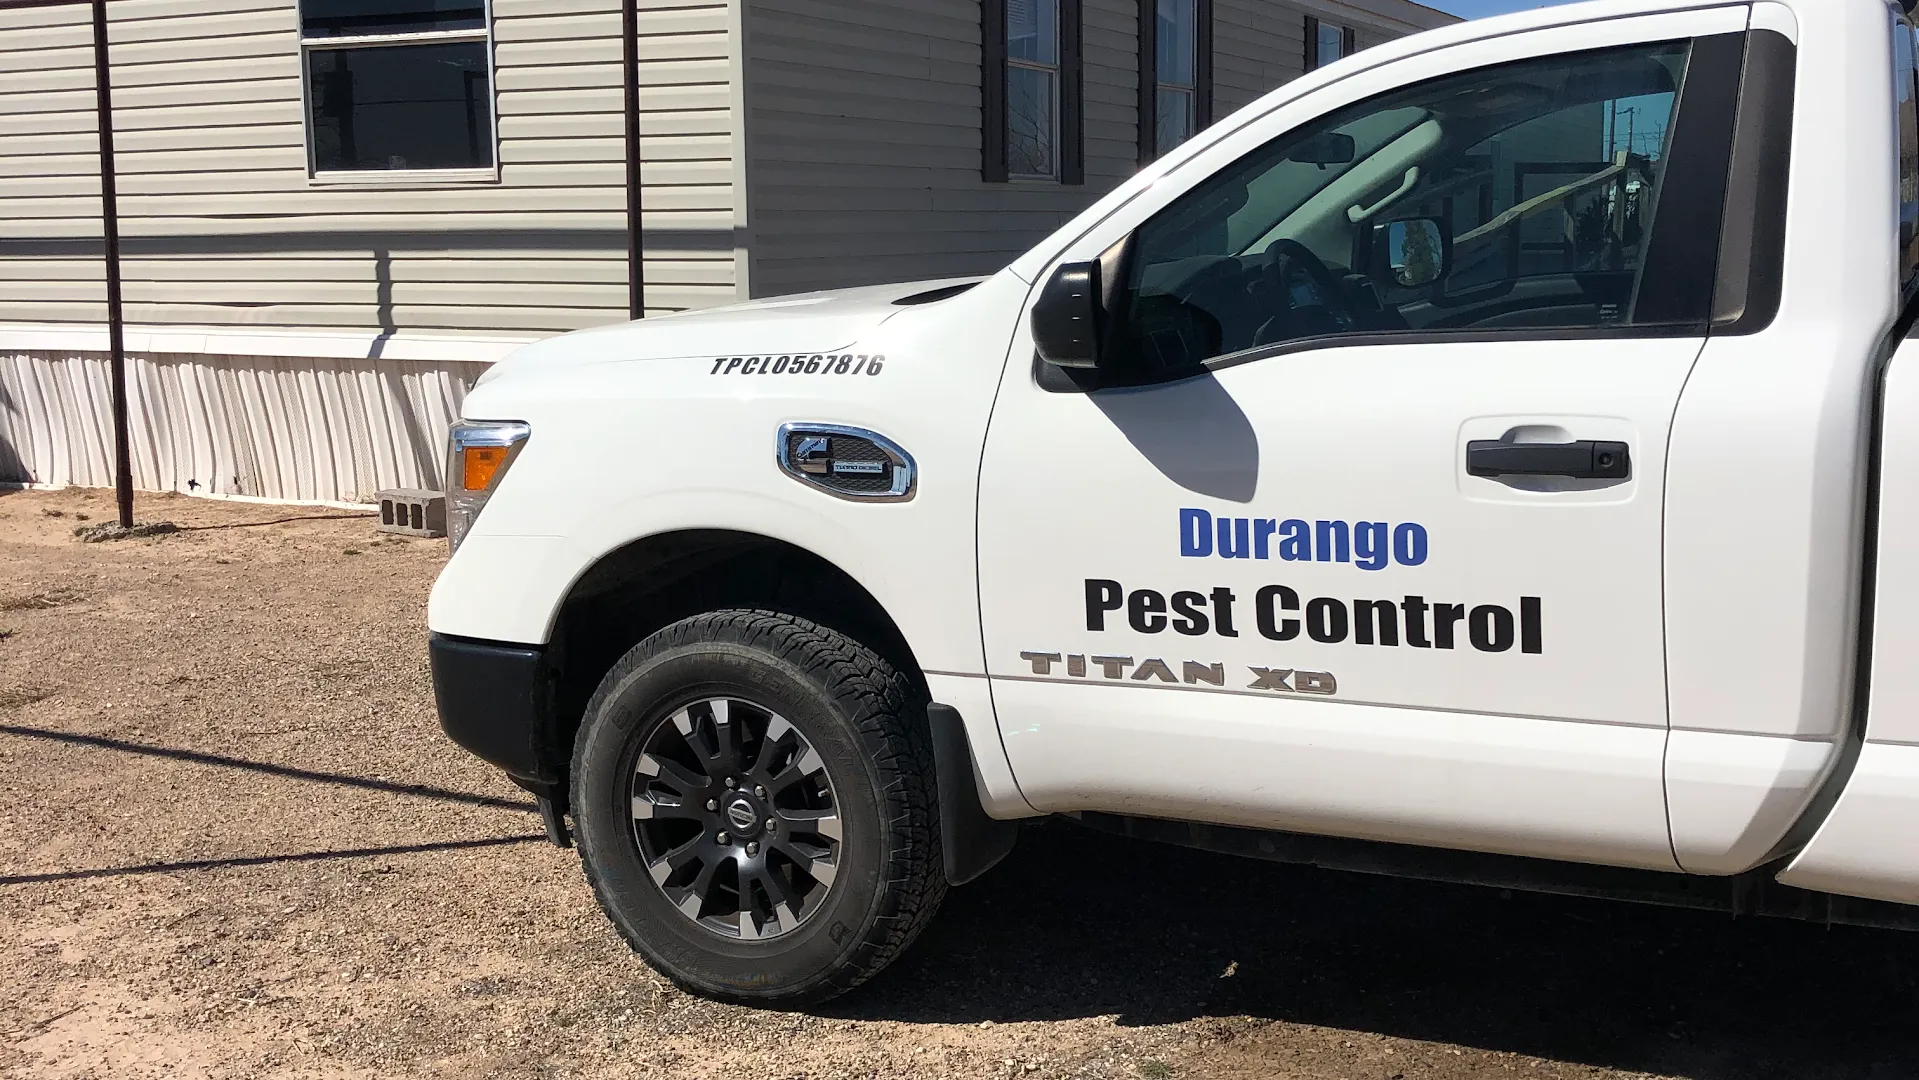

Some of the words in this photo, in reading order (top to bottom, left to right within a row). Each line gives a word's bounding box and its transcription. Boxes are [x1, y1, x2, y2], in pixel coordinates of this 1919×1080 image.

[1179, 508, 1428, 571] Durango
[1084, 578, 1239, 638] Pest
[1255, 584, 1543, 655] Control
[1019, 650, 1225, 687] TITAN
[1246, 665, 1338, 696] XD
